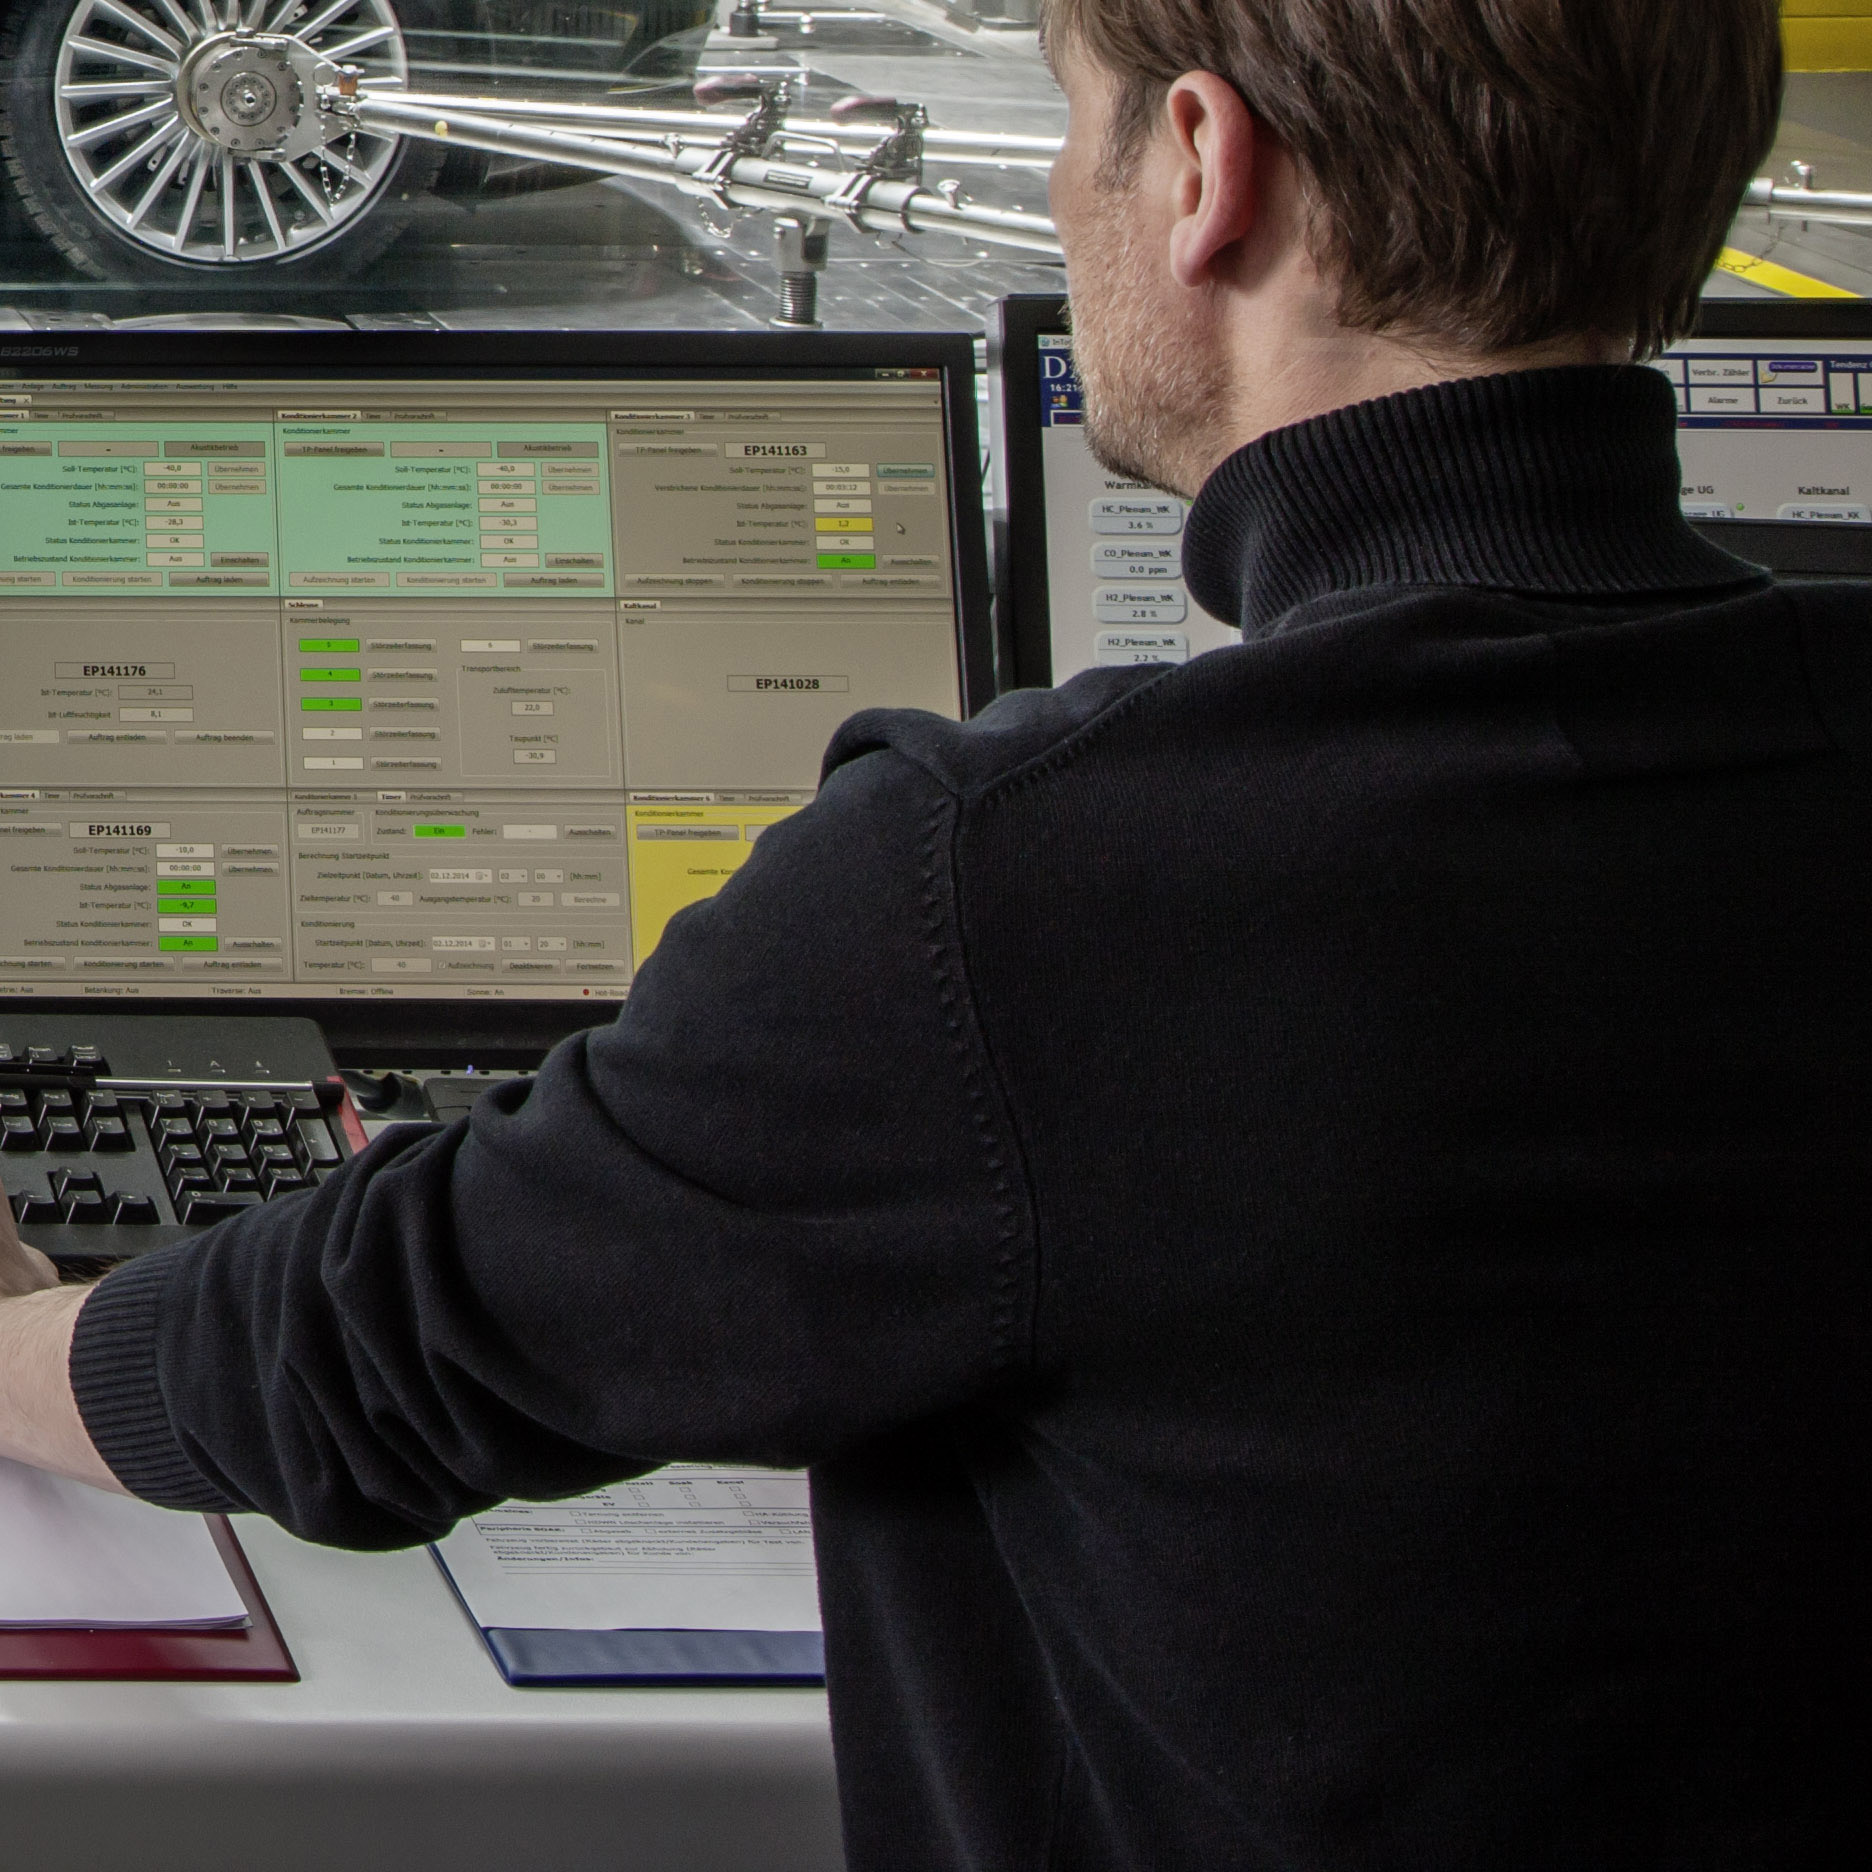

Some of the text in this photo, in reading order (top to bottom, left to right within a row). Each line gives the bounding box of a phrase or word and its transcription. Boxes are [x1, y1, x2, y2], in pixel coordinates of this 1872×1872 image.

[743, 445, 807, 456] EP141163
[1798, 487, 1849, 495] Kaltkanal
[83, 666, 146, 677] EP141176
[756, 679, 820, 690] EP141028
[88, 826, 152, 836] EP141169
